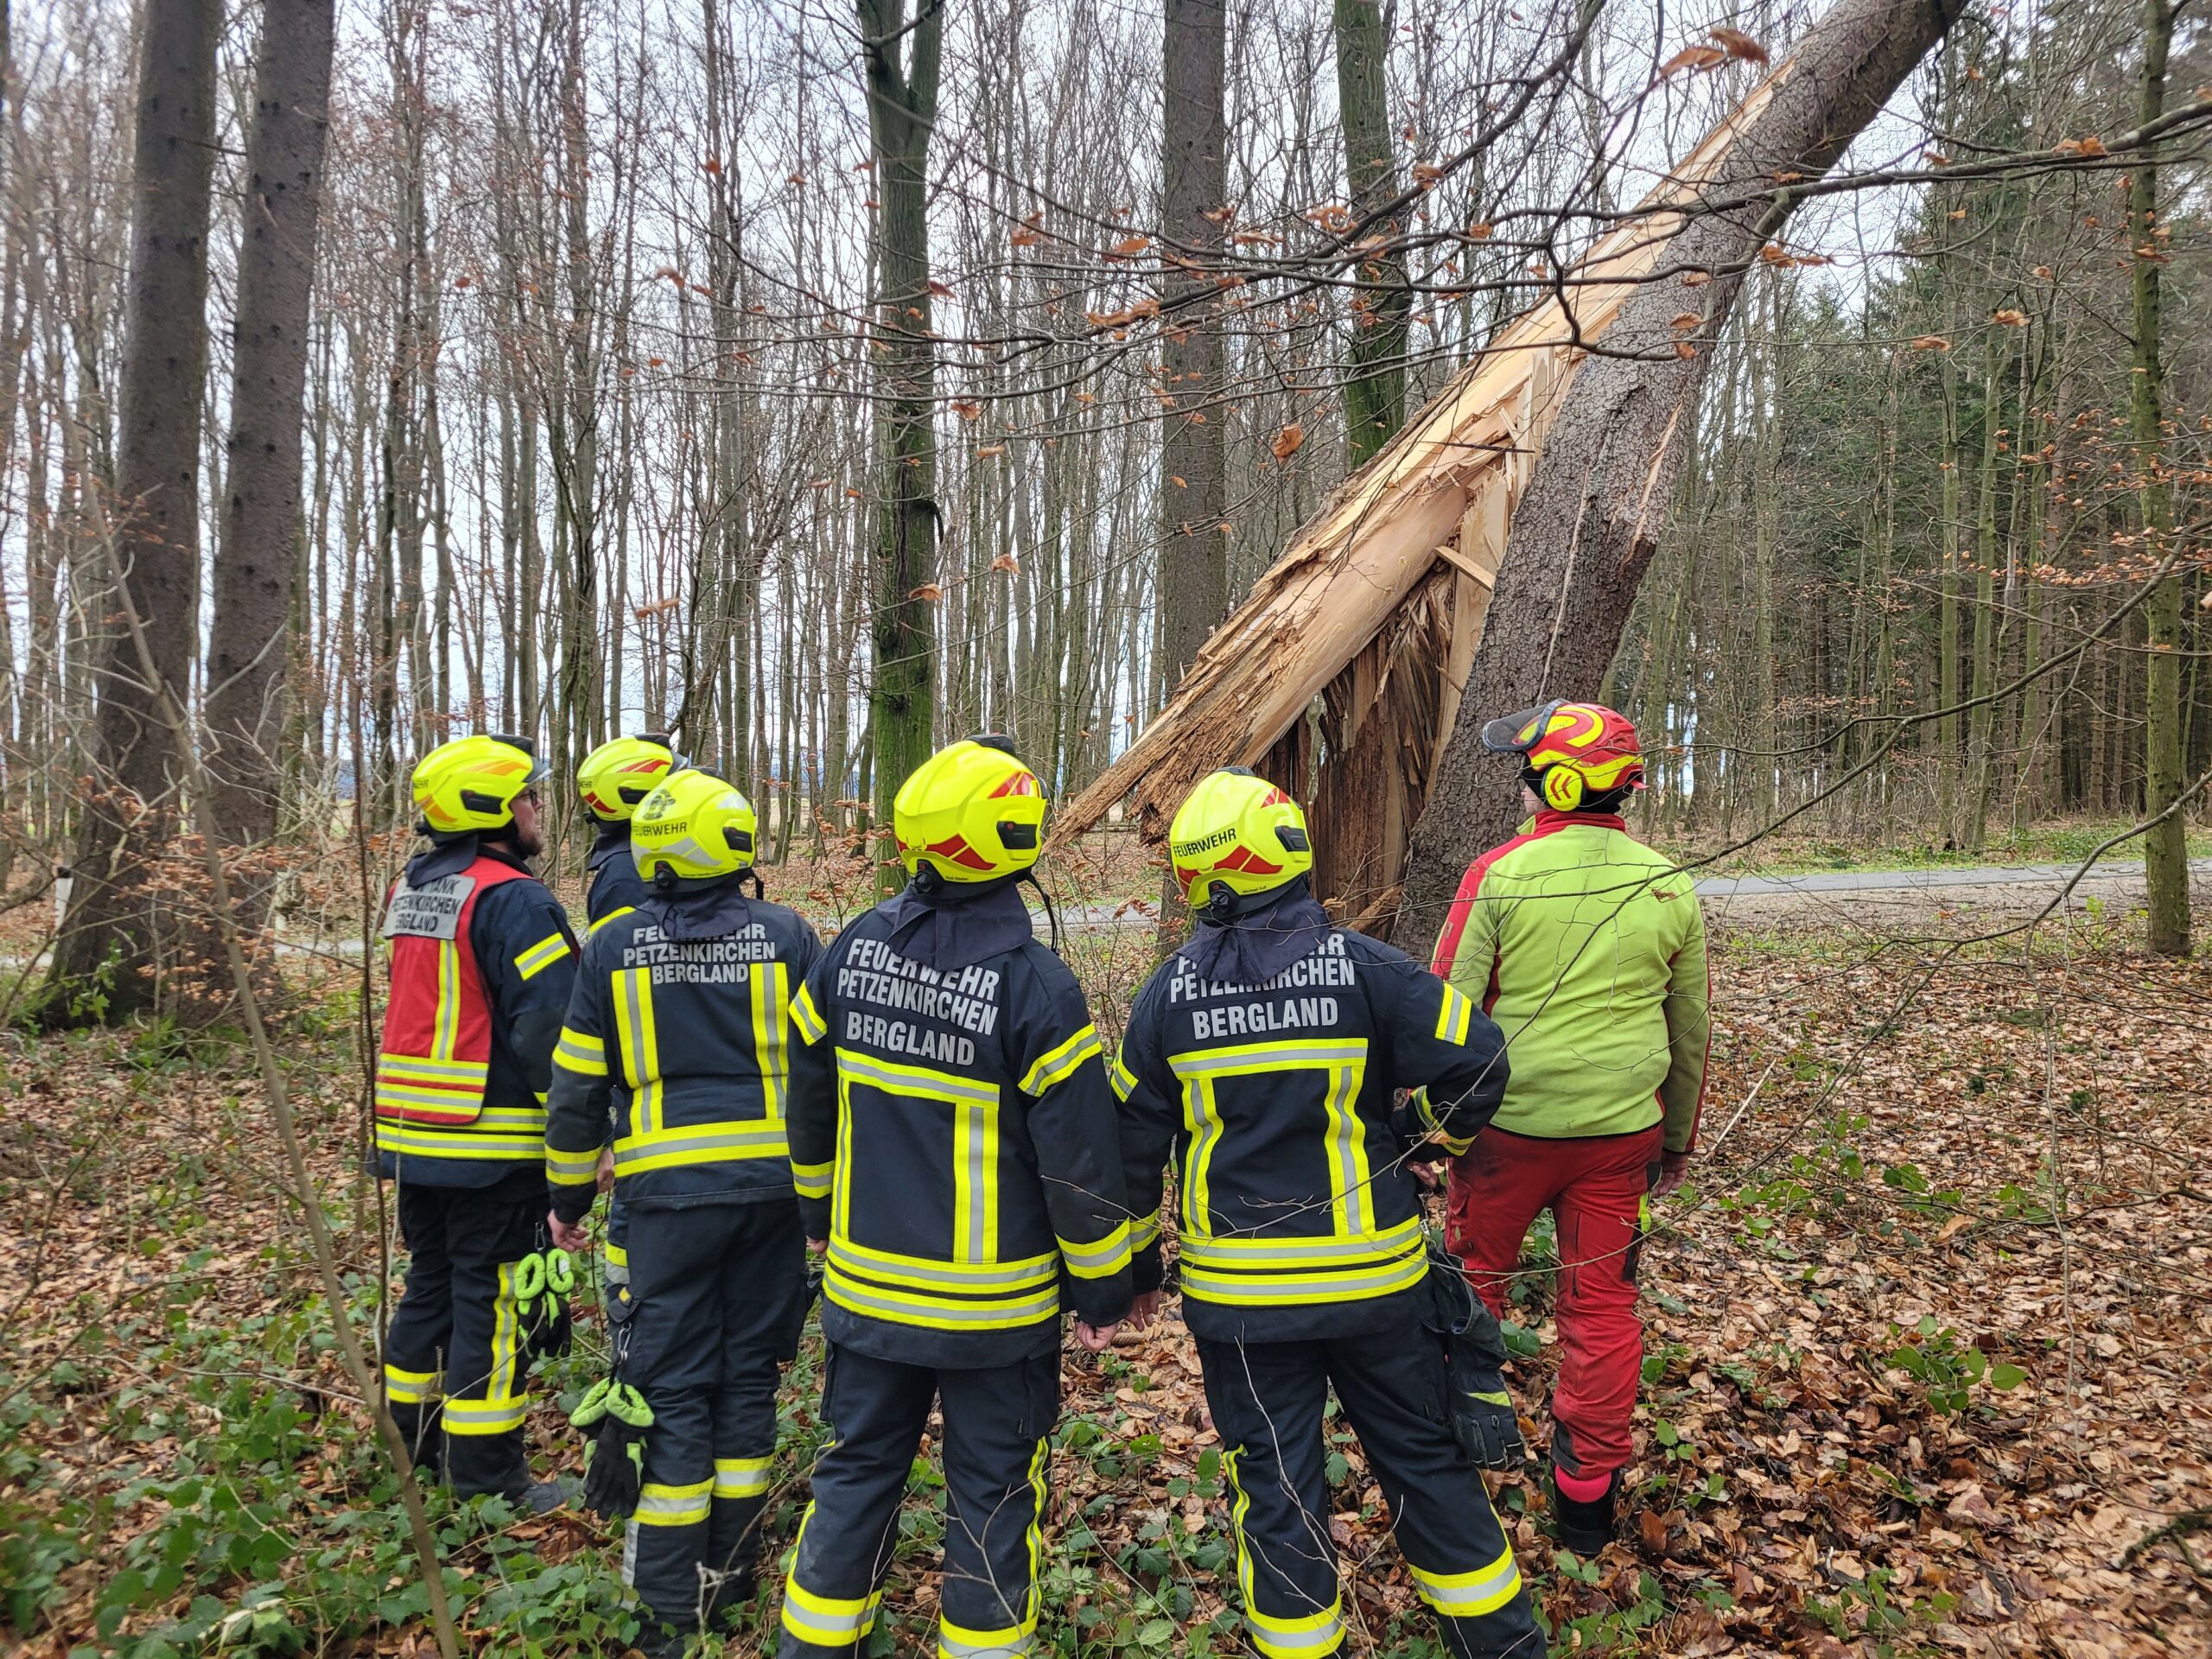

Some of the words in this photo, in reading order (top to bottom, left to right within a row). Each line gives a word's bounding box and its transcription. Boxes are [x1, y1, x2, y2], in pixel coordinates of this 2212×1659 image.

[1173, 828, 1236, 857] FEUERWEHR
[623, 941, 776, 967] PETZENKIRCHEN
[652, 964, 749, 985] BERGLAND
[837, 968, 999, 1036] PETZENKIRCHEN
[1192, 996, 1338, 1040] BERGLAND
[846, 1011, 976, 1066] BERGLAND
